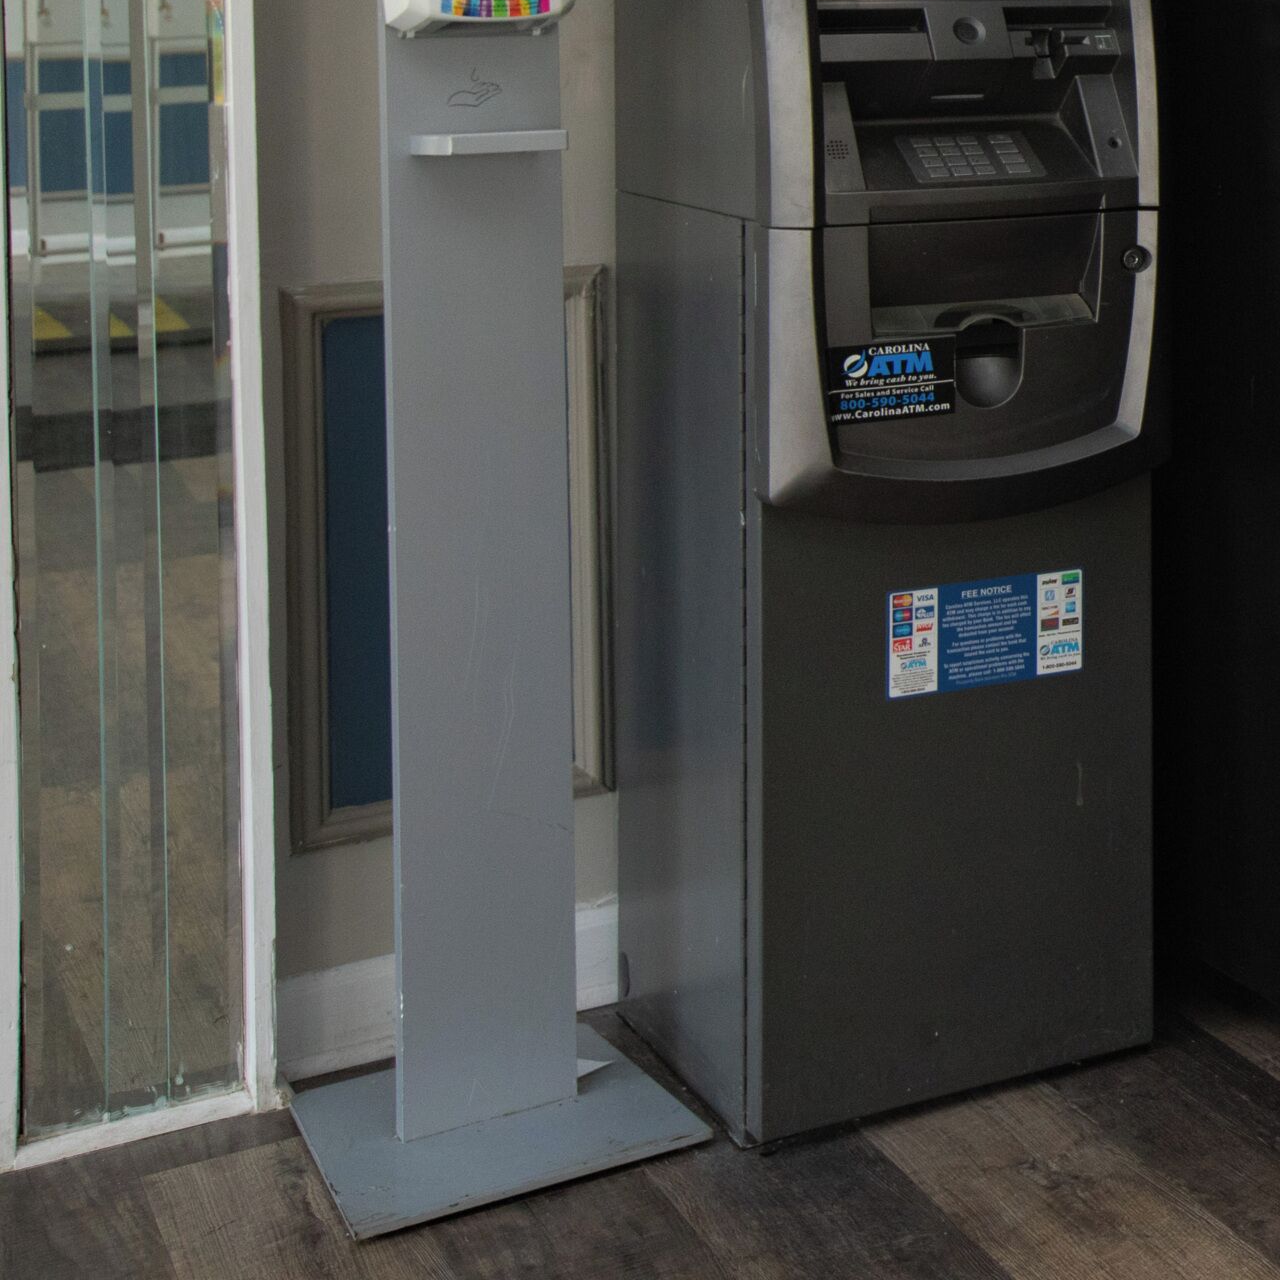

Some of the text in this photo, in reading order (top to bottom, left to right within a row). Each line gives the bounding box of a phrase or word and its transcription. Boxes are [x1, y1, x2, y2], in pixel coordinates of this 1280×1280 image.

[868, 342, 930, 356] CAROLINA
[867, 351, 935, 377] ATM
[845, 379, 858, 387] We
[860, 377, 885, 386] bring
[886, 375, 907, 384] cash
[918, 373, 937, 382] you.
[840, 384, 935, 400] For Sales and Service Call
[840, 391, 935, 411] 800-590-5044
[916, 593, 934, 602] VISA
[961, 584, 1013, 599] FEE NOTICE
[893, 642, 911, 652] STAR
[1050, 641, 1080, 656] ATM
